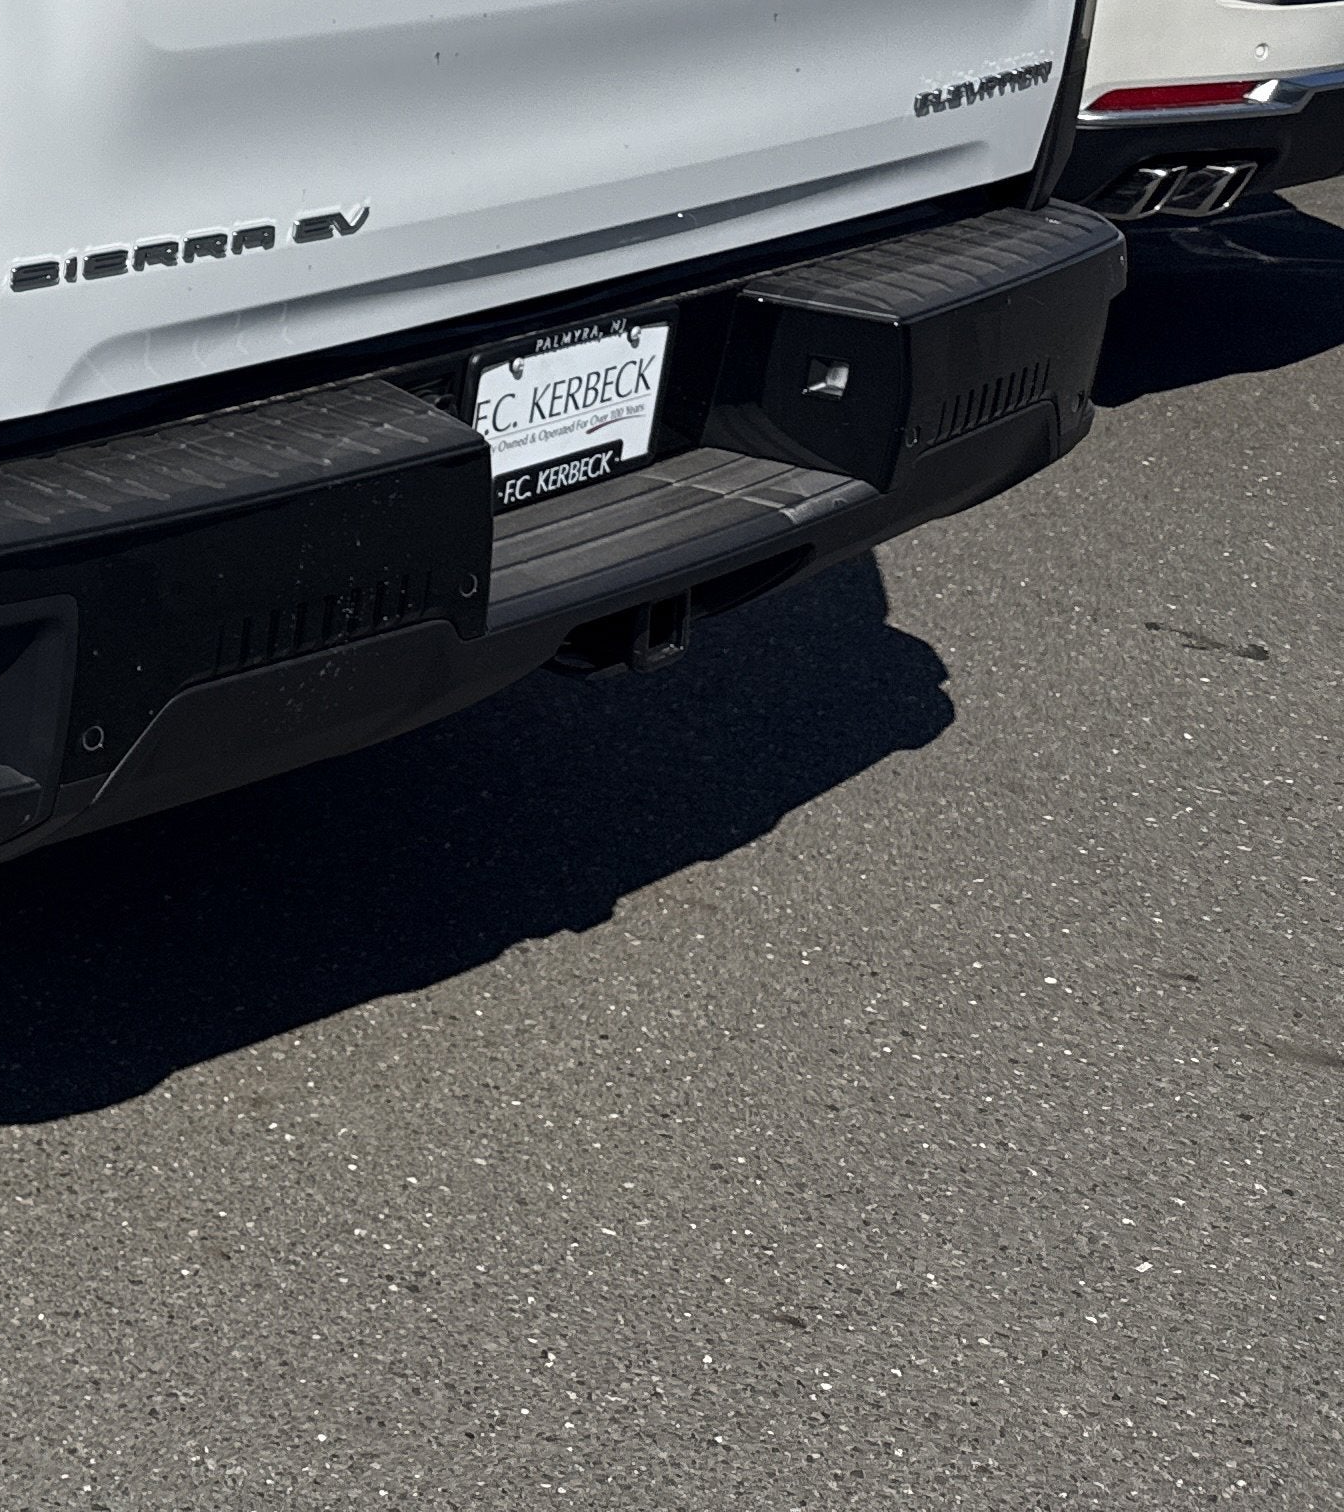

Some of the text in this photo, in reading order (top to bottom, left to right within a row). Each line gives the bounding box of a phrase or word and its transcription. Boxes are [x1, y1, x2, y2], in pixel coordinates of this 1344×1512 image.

[9, 205, 370, 292] SIERRA EV
[535, 318, 627, 352] PALMYRA, NJ
[474, 355, 656, 435] F.C. KERBECK
[498, 434, 528, 452] Owned
[529, 434, 536, 443] &
[538, 423, 575, 442] Operated
[590, 413, 608, 426] Over
[536, 450, 613, 494] KERBECK
